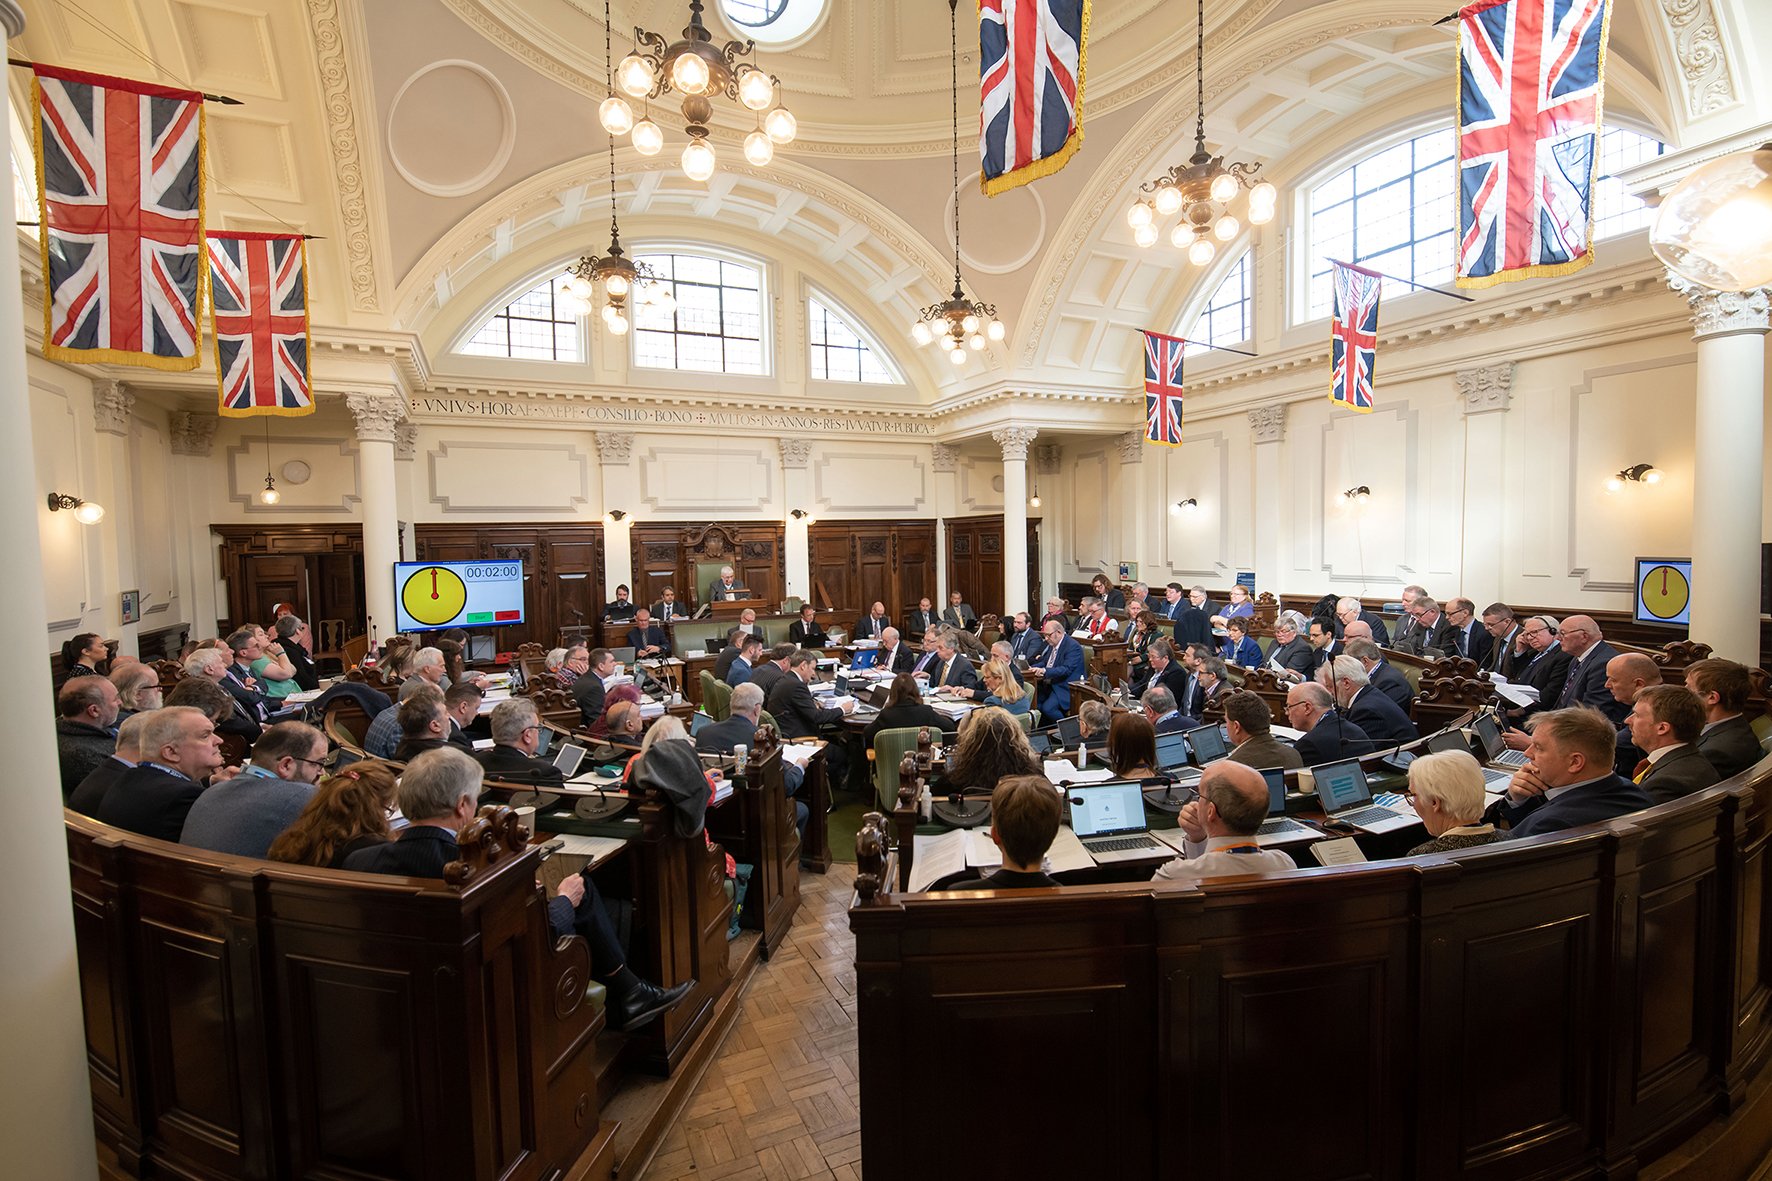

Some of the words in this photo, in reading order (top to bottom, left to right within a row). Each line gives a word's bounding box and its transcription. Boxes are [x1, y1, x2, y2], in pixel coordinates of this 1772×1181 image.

[424, 399, 475, 414] VNIVS
[481, 402, 531, 415] HORAE
[540, 405, 579, 418] SAEPE
[587, 407, 648, 421] CONSILIO
[655, 410, 692, 422] BONO
[709, 413, 756, 425] MVLTOS
[761, 415, 774, 426] IN
[778, 417, 818, 428] ANNOS
[823, 418, 841, 430] RES
[846, 420, 890, 432] IVVATVR
[467, 566, 517, 578] 00:02:00
